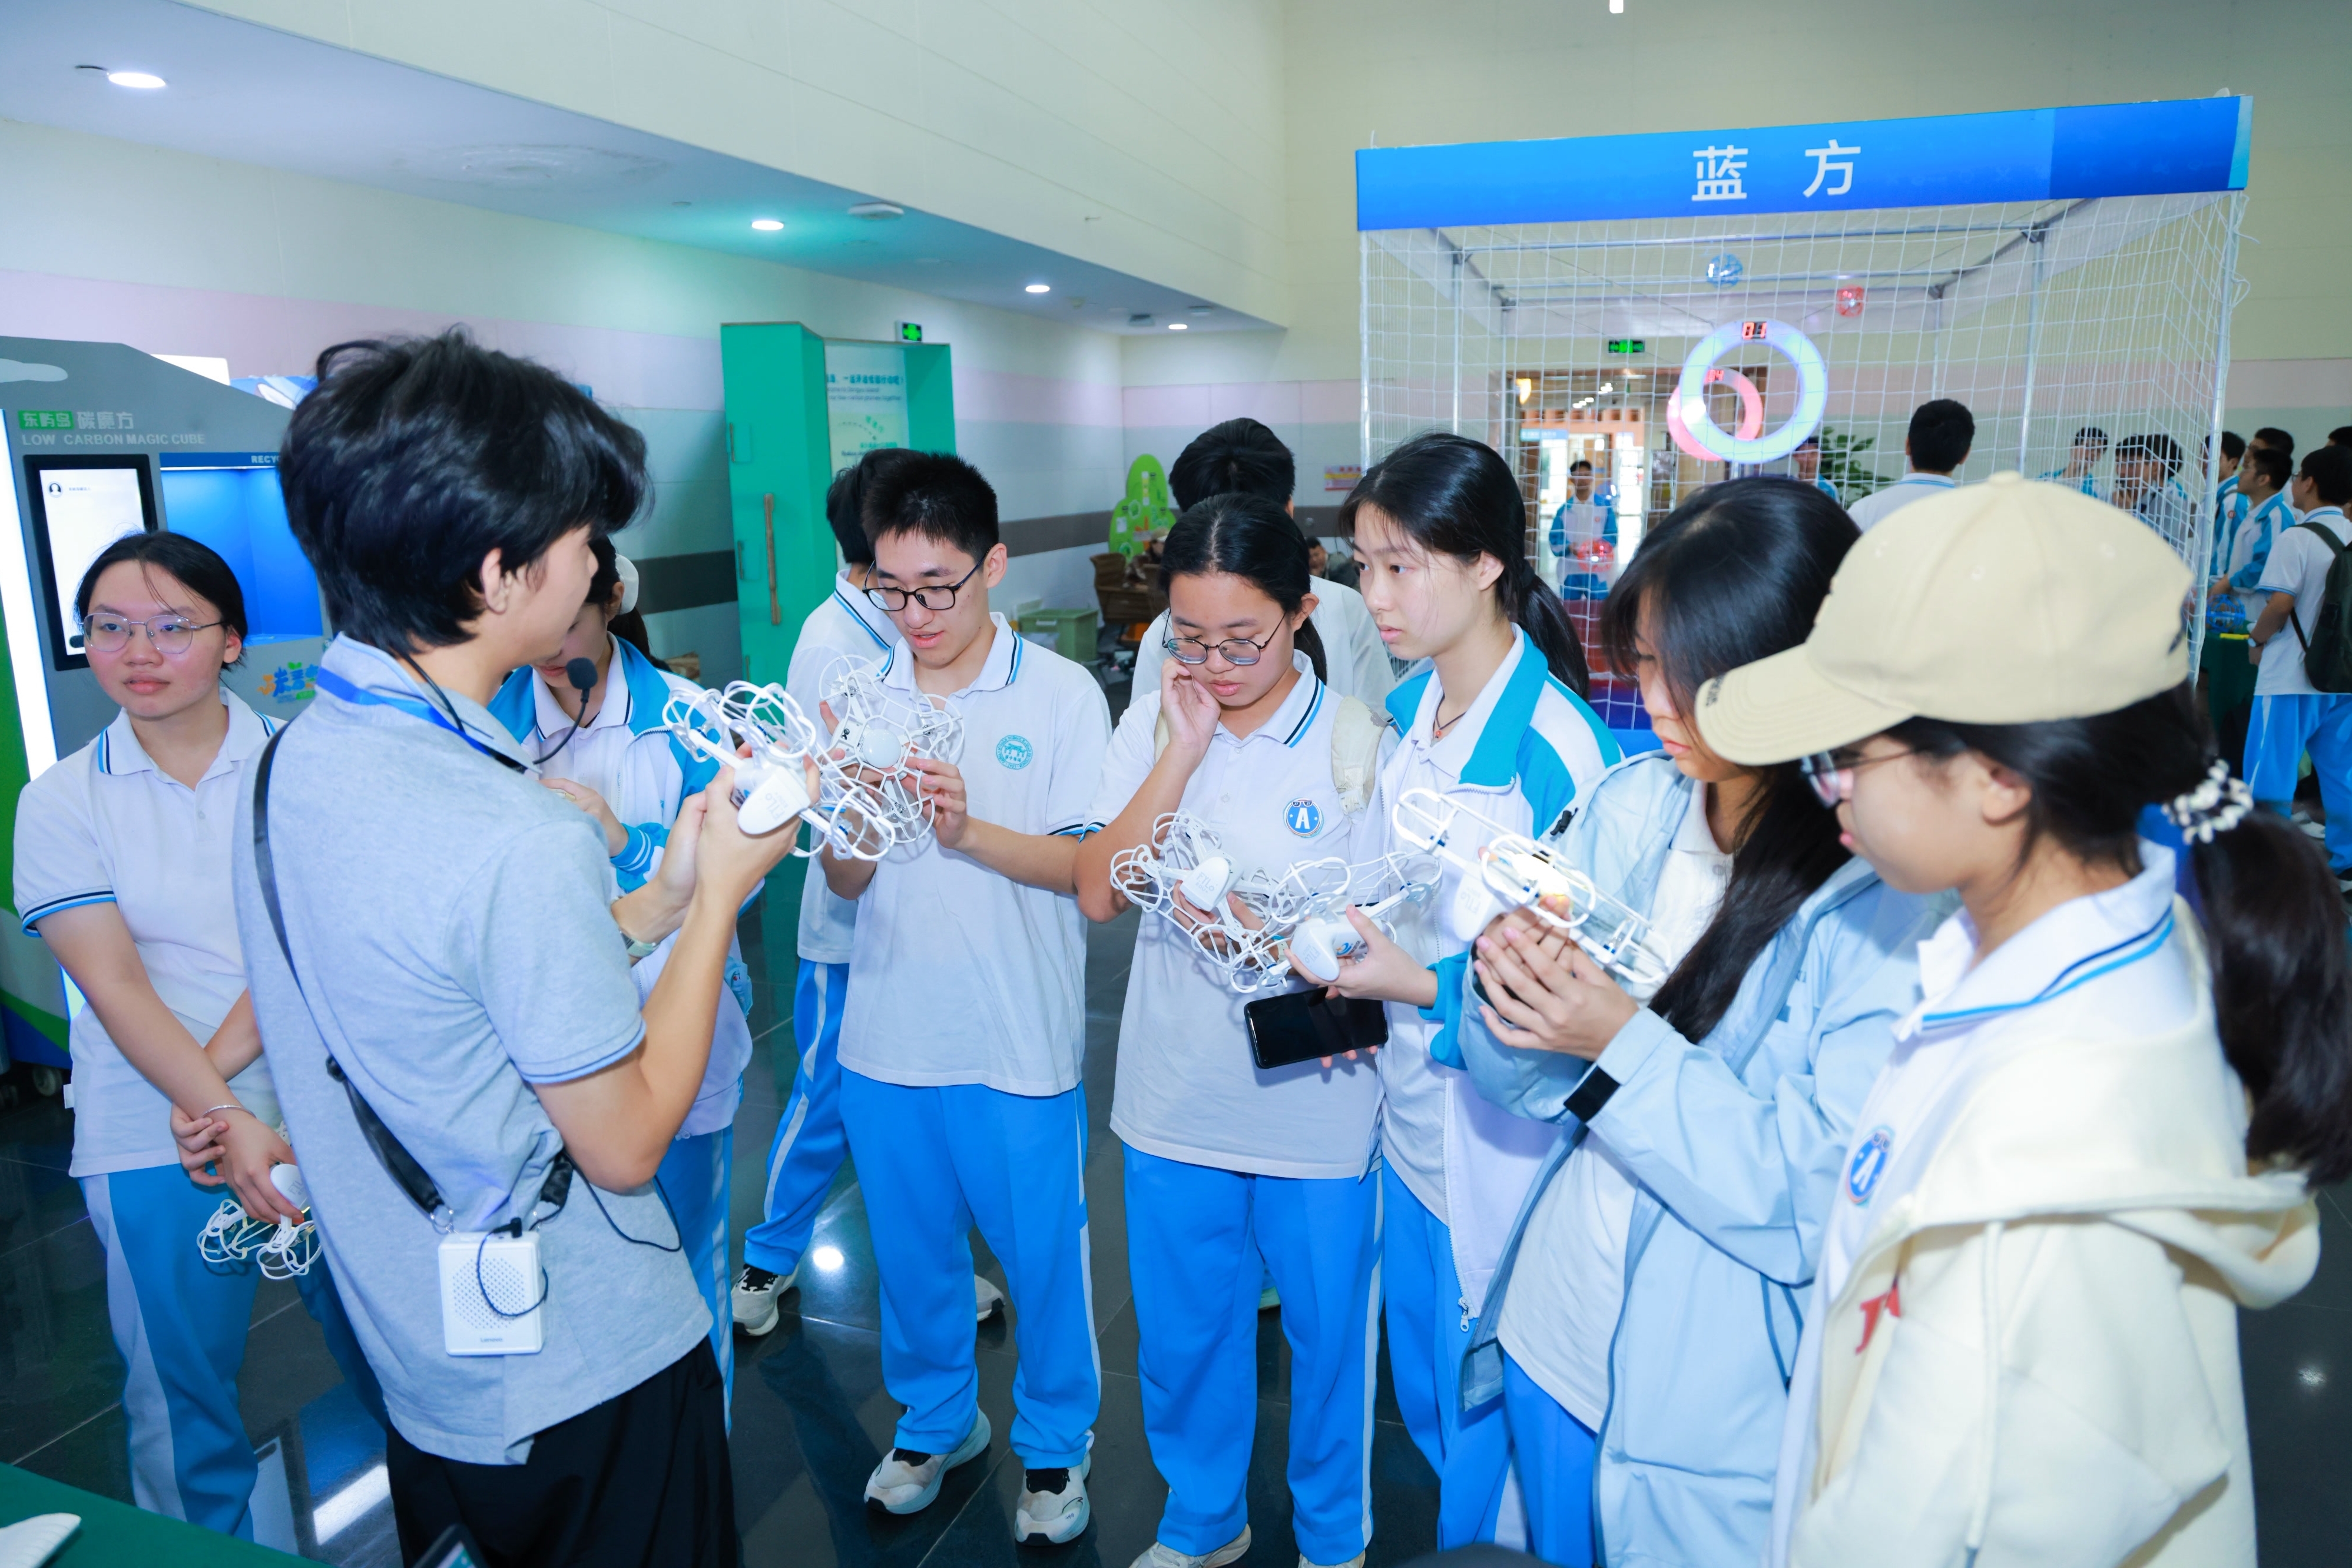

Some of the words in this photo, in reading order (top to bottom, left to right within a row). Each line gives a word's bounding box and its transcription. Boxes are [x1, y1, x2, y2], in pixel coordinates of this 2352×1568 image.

[1692, 139, 1861, 201] 蓝方
[1742, 321, 1767, 340] 01
[22, 412, 71, 427] 东屿岛
[77, 411, 134, 429] 碳魔方
[22, 434, 55, 445] LOW
[64, 434, 122, 445] CARBON
[127, 434, 168, 445] MAGIC
[171, 433, 205, 445] CUBE
[1295, 807, 1310, 830] A
